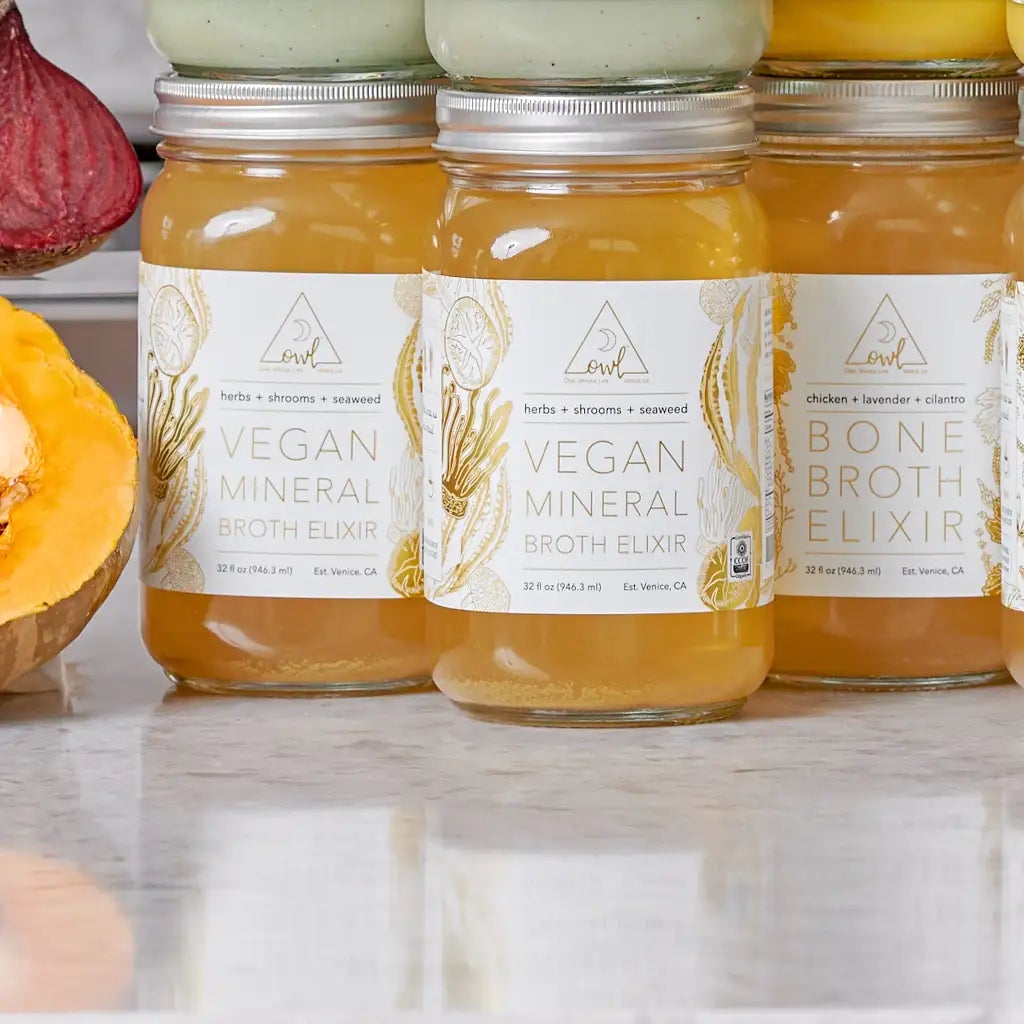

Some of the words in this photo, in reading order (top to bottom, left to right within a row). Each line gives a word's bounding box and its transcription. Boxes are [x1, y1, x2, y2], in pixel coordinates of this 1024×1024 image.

[281, 336, 320, 368] owl
[586, 346, 626, 378] owl
[867, 338, 905, 369] owl
[221, 391, 251, 401] herbs
[269, 392, 315, 403] shrooms
[333, 394, 381, 404] seaweed
[524, 404, 555, 414] herbs
[574, 404, 621, 414] shrooms
[640, 404, 688, 414] seaweed
[807, 394, 847, 404] chicken
[863, 394, 910, 404] lavender
[925, 394, 965, 404] cilantro
[220, 426, 376, 461] VEGAN
[810, 420, 963, 454] BONE
[525, 440, 684, 474] VEGAN
[221, 475, 379, 503] MINERAL
[809, 465, 962, 498] BROTH
[526, 490, 688, 517] MINERAL
[219, 518, 297, 539] BROTH
[309, 521, 377, 539] ELIXIR
[809, 510, 963, 542] ELIXIR
[525, 534, 606, 554] BROTH
[618, 534, 686, 554] ELIXIR
[537, 582, 541, 590] fl
[557, 583, 584, 591] (946.3
[588, 583, 601, 591] ml)
[640, 583, 671, 591] Venice,
[674, 582, 687, 590] CA
